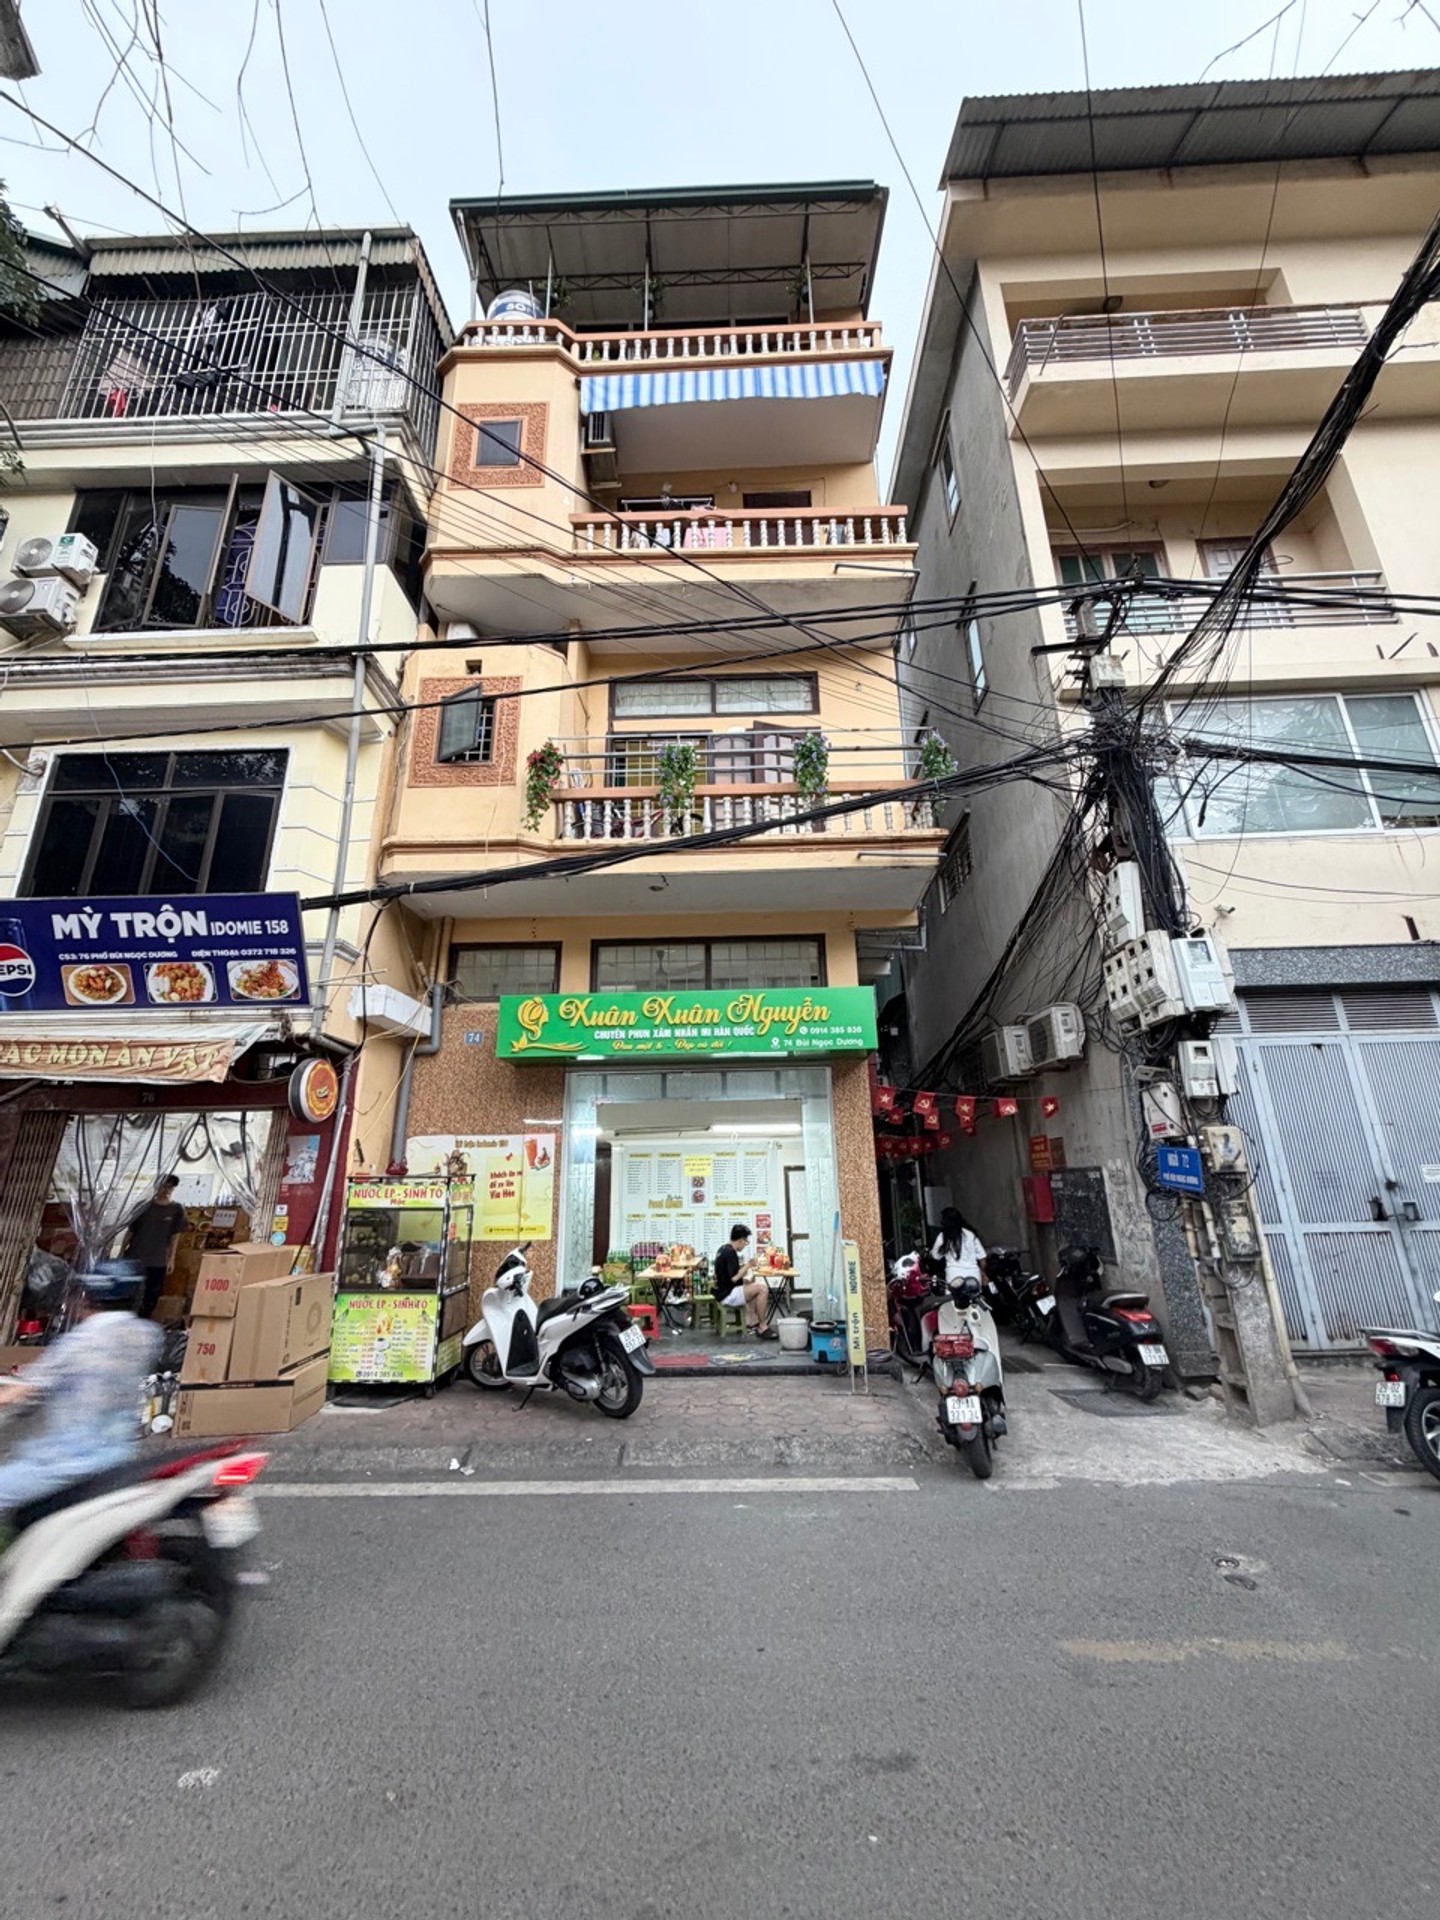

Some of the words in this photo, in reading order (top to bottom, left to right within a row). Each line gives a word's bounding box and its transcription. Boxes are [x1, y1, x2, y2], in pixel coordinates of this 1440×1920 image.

[51, 906, 103, 939] MỲ
[110, 904, 208, 943] TRỘN
[211, 922, 262, 936] IDOMIE
[264, 919, 289, 934] 158
[0, 963, 33, 976] EPSI
[558, 998, 638, 1027] Xuân
[642, 996, 722, 1025] Xuân
[727, 993, 832, 1036] Nguyễn
[628, 1028, 651, 1039] PHUN
[714, 1025, 731, 1036] HÀN
[733, 1023, 755, 1036] QUỐC
[0, 1040, 42, 1064] ÁC
[403, 1187, 427, 1199] SINH
[204, 1278, 229, 1291] 1000
[196, 1343, 216, 1355] 750
